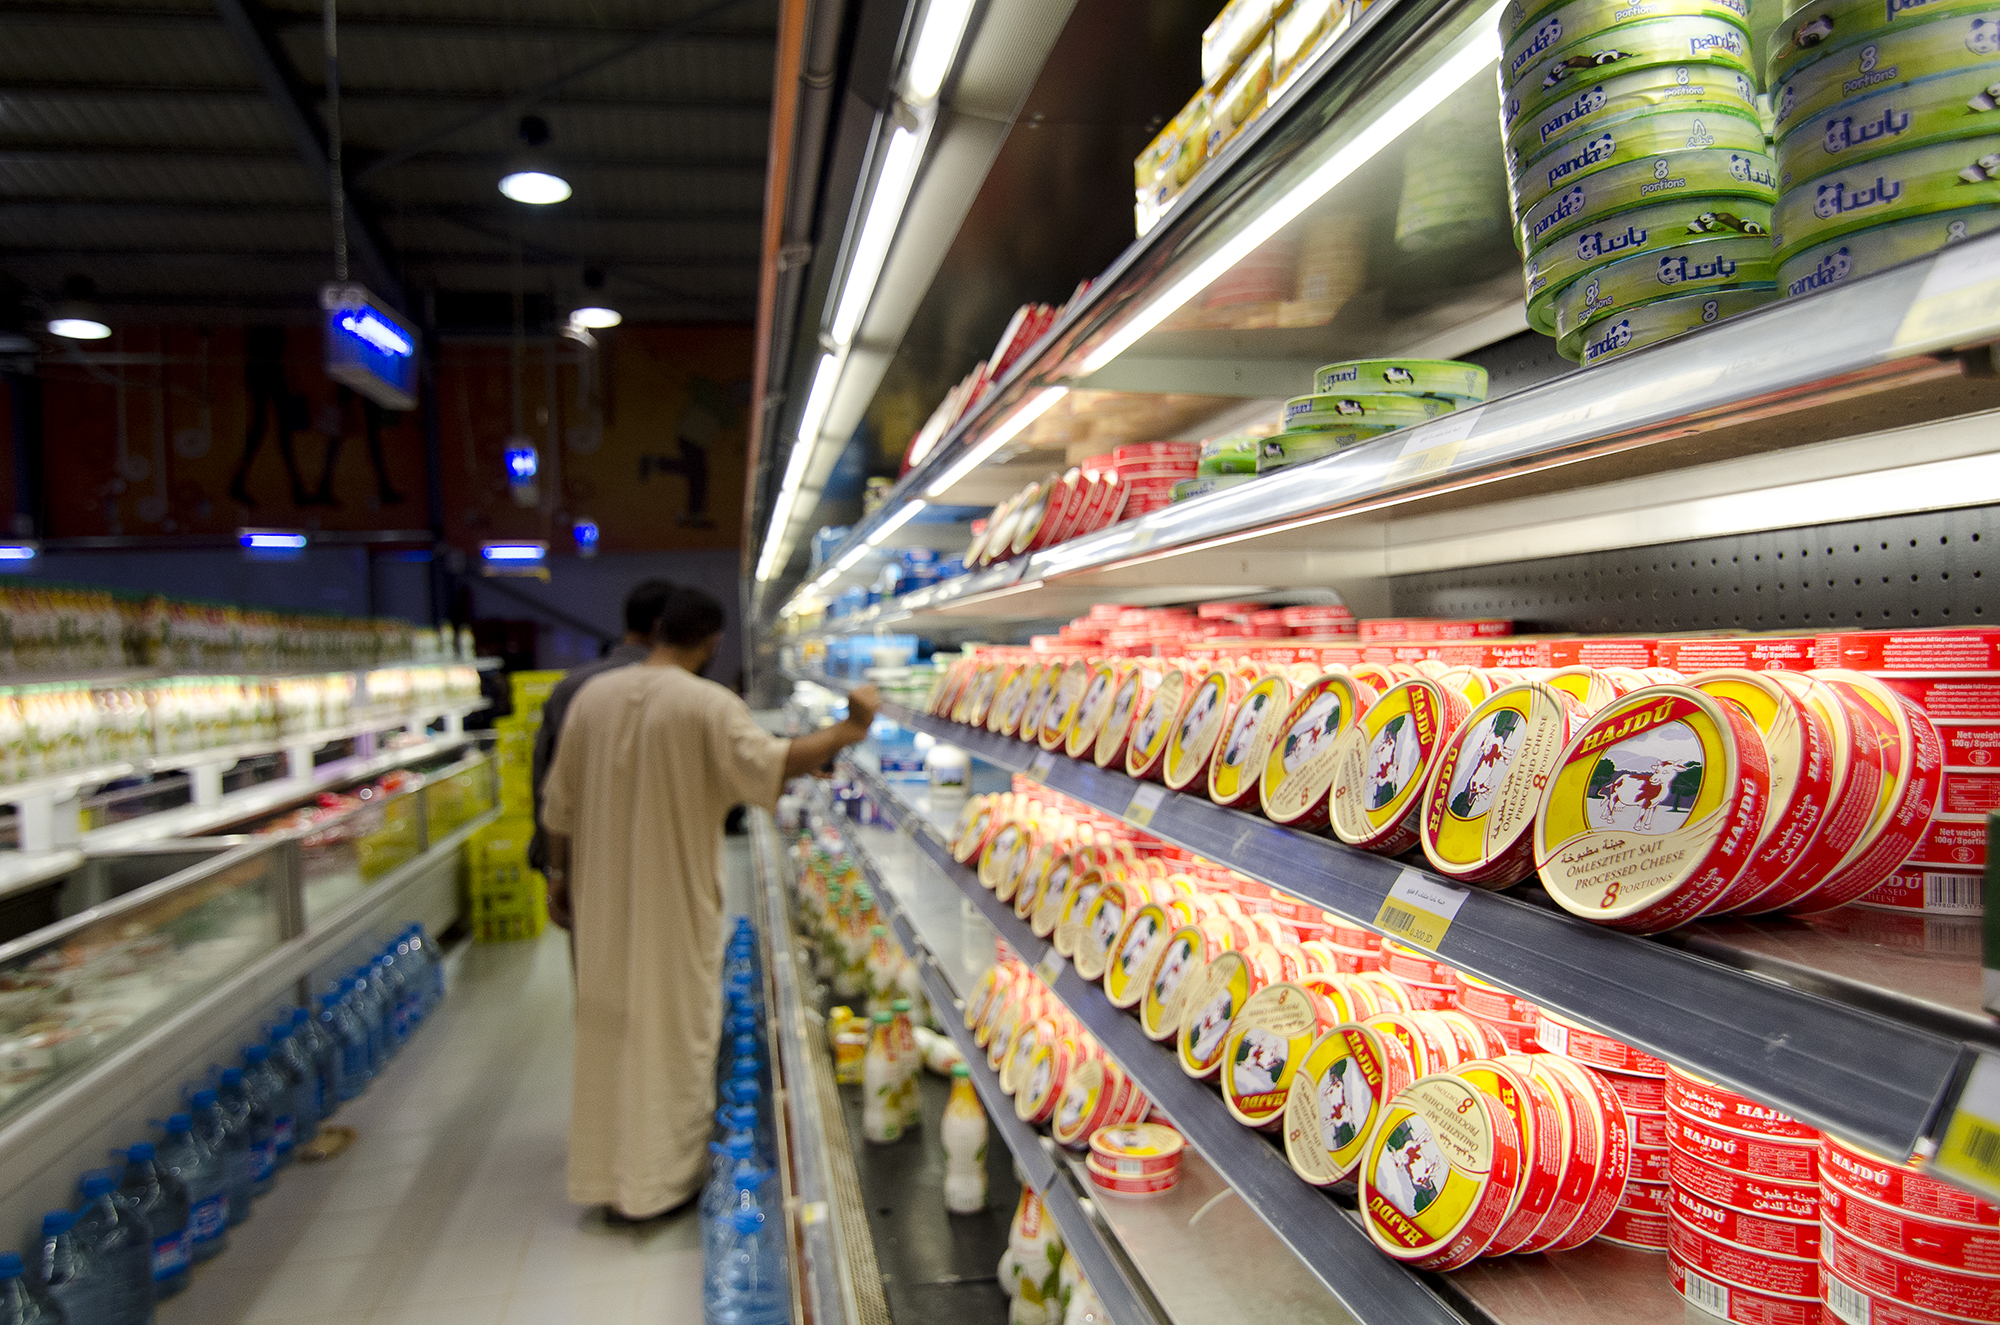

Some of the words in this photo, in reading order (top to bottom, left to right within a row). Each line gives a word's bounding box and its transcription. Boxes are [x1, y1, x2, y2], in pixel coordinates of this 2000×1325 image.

[1511, 32, 1550, 78] panda
[1859, 44, 1878, 73] 8
[1676, 67, 1689, 85] 8
[1842, 66, 1898, 96] portions
[1664, 85, 1705, 98] portions
[1540, 98, 1593, 143] panda
[1547, 145, 1601, 188] panda
[1654, 159, 1669, 180] 8
[1641, 177, 1685, 196] portions
[1533, 198, 1571, 243] panda
[1702, 301, 1718, 322] 8
[1412, 688, 1435, 745] HAJDÚ
[1579, 696, 1675, 754] HAJDÚ
[1800, 710, 1821, 783] HAJDÚ
[1957, 731, 1972, 739] Net
[1540, 722, 1558, 774] PORTIONS
[1515, 758, 1537, 820] PROCESSED
[1533, 715, 1548, 757] CHEESE
[1336, 786, 1346, 798] 8
[1502, 772, 1514, 796] جبنة
[1533, 774, 1548, 790] 8
[1720, 776, 1759, 858] HAJDÚ
[1792, 794, 1812, 818] جبنة
[1799, 804, 1820, 832] قابلة
[1490, 798, 1507, 840] مطبوخة
[1602, 838, 1626, 850] جبنة
[1760, 822, 1798, 862] مطبوخة
[1940, 828, 1954, 836] Net
[1561, 846, 1599, 864] مطبوخة
[1781, 832, 1804, 864] للدهن
[1574, 864, 1637, 890] PROCESSED
[1640, 849, 1687, 871] CHEESE
[1693, 866, 1719, 888] جبنة
[1600, 881, 1620, 909] 8
[1618, 872, 1674, 896] PORTIONS
[1698, 873, 1726, 898] قابلة
[1653, 888, 1698, 916] مطبوخة
[1346, 1031, 1382, 1086] HAJDÚ
[1422, 1092, 1444, 1112] CHEESE
[1433, 1084, 1462, 1107] PORTIONS
[1676, 1082, 1704, 1102] مطبوخة
[1704, 1094, 1726, 1110] جبنة
[1457, 1098, 1474, 1114] 8
[1680, 1098, 1700, 1112] للدهن
[1700, 1103, 1720, 1119] قابلة
[1736, 1103, 1804, 1124] HAJD
[1444, 1110, 1480, 1136] PROCESSED
[1290, 1130, 1302, 1142] 8
[1682, 1126, 1738, 1155] HAJDÚ
[1440, 1132, 1452, 1149] جبنة
[1453, 1144, 1476, 1167] مطبوخة
[1831, 1150, 1889, 1186] HAJDÚ
[1746, 1183, 1790, 1200] مطبوخة
[1792, 1191, 1818, 1204] جبنة
[1678, 1192, 1726, 1223] HAJDÚ
[1752, 1199, 1784, 1212] للدهن
[1786, 1202, 1813, 1216] قابلة
[1368, 1196, 1424, 1248] HAJDÚ
[1429, 1235, 1473, 1266] HAJDÚ
